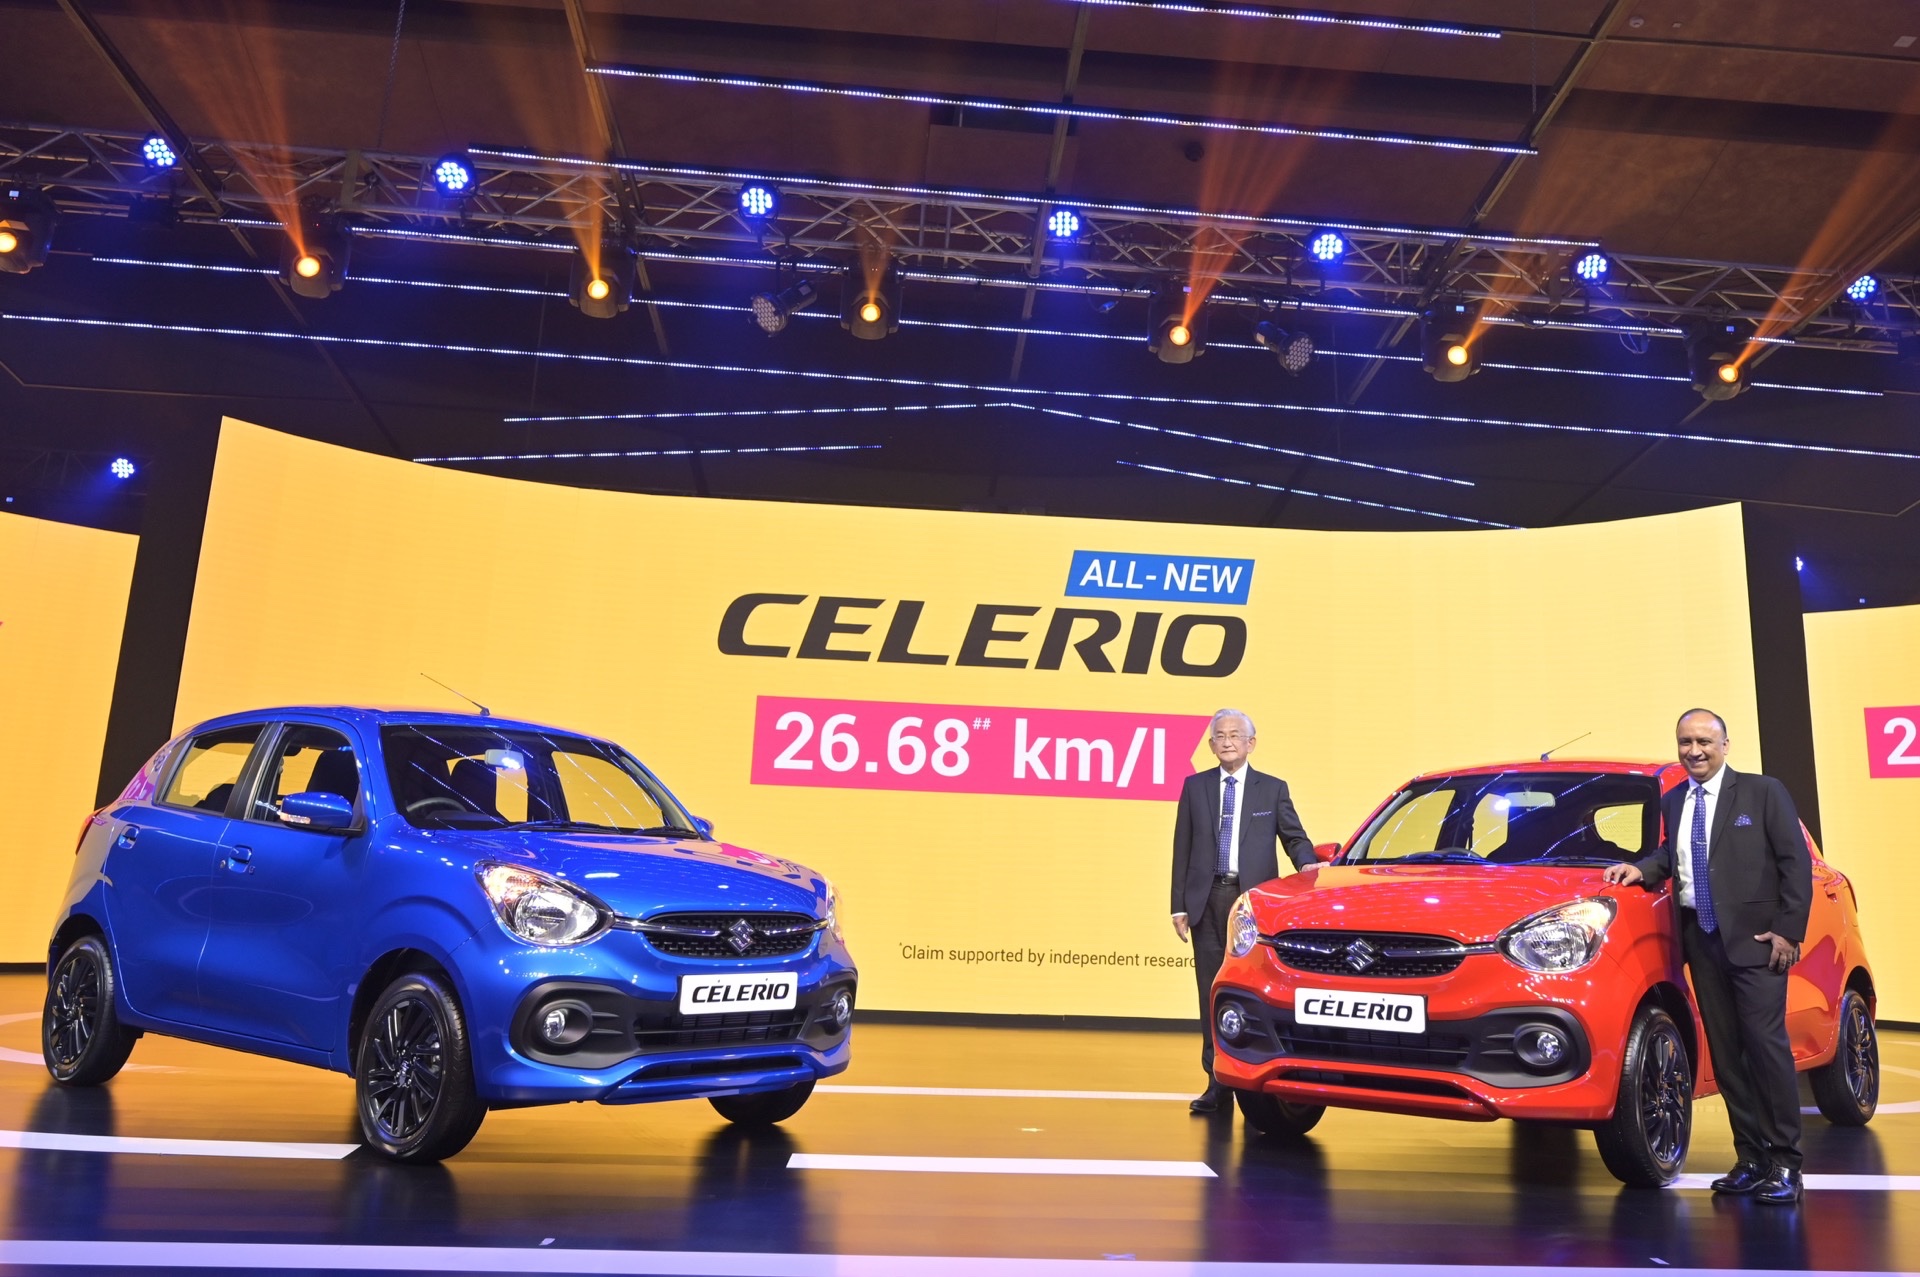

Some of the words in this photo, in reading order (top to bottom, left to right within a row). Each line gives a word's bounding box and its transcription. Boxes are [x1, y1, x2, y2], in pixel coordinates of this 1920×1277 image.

[717, 592, 1248, 678] CELERIO
[1013, 717, 1166, 788] km/l
[948, 948, 1024, 965] supported
[1028, 948, 1046, 967] by
[1049, 949, 1140, 968] independent
[1144, 956, 1196, 968] researc
[692, 983, 790, 1003] CELERIO
[1303, 998, 1413, 1022] CELERIO
